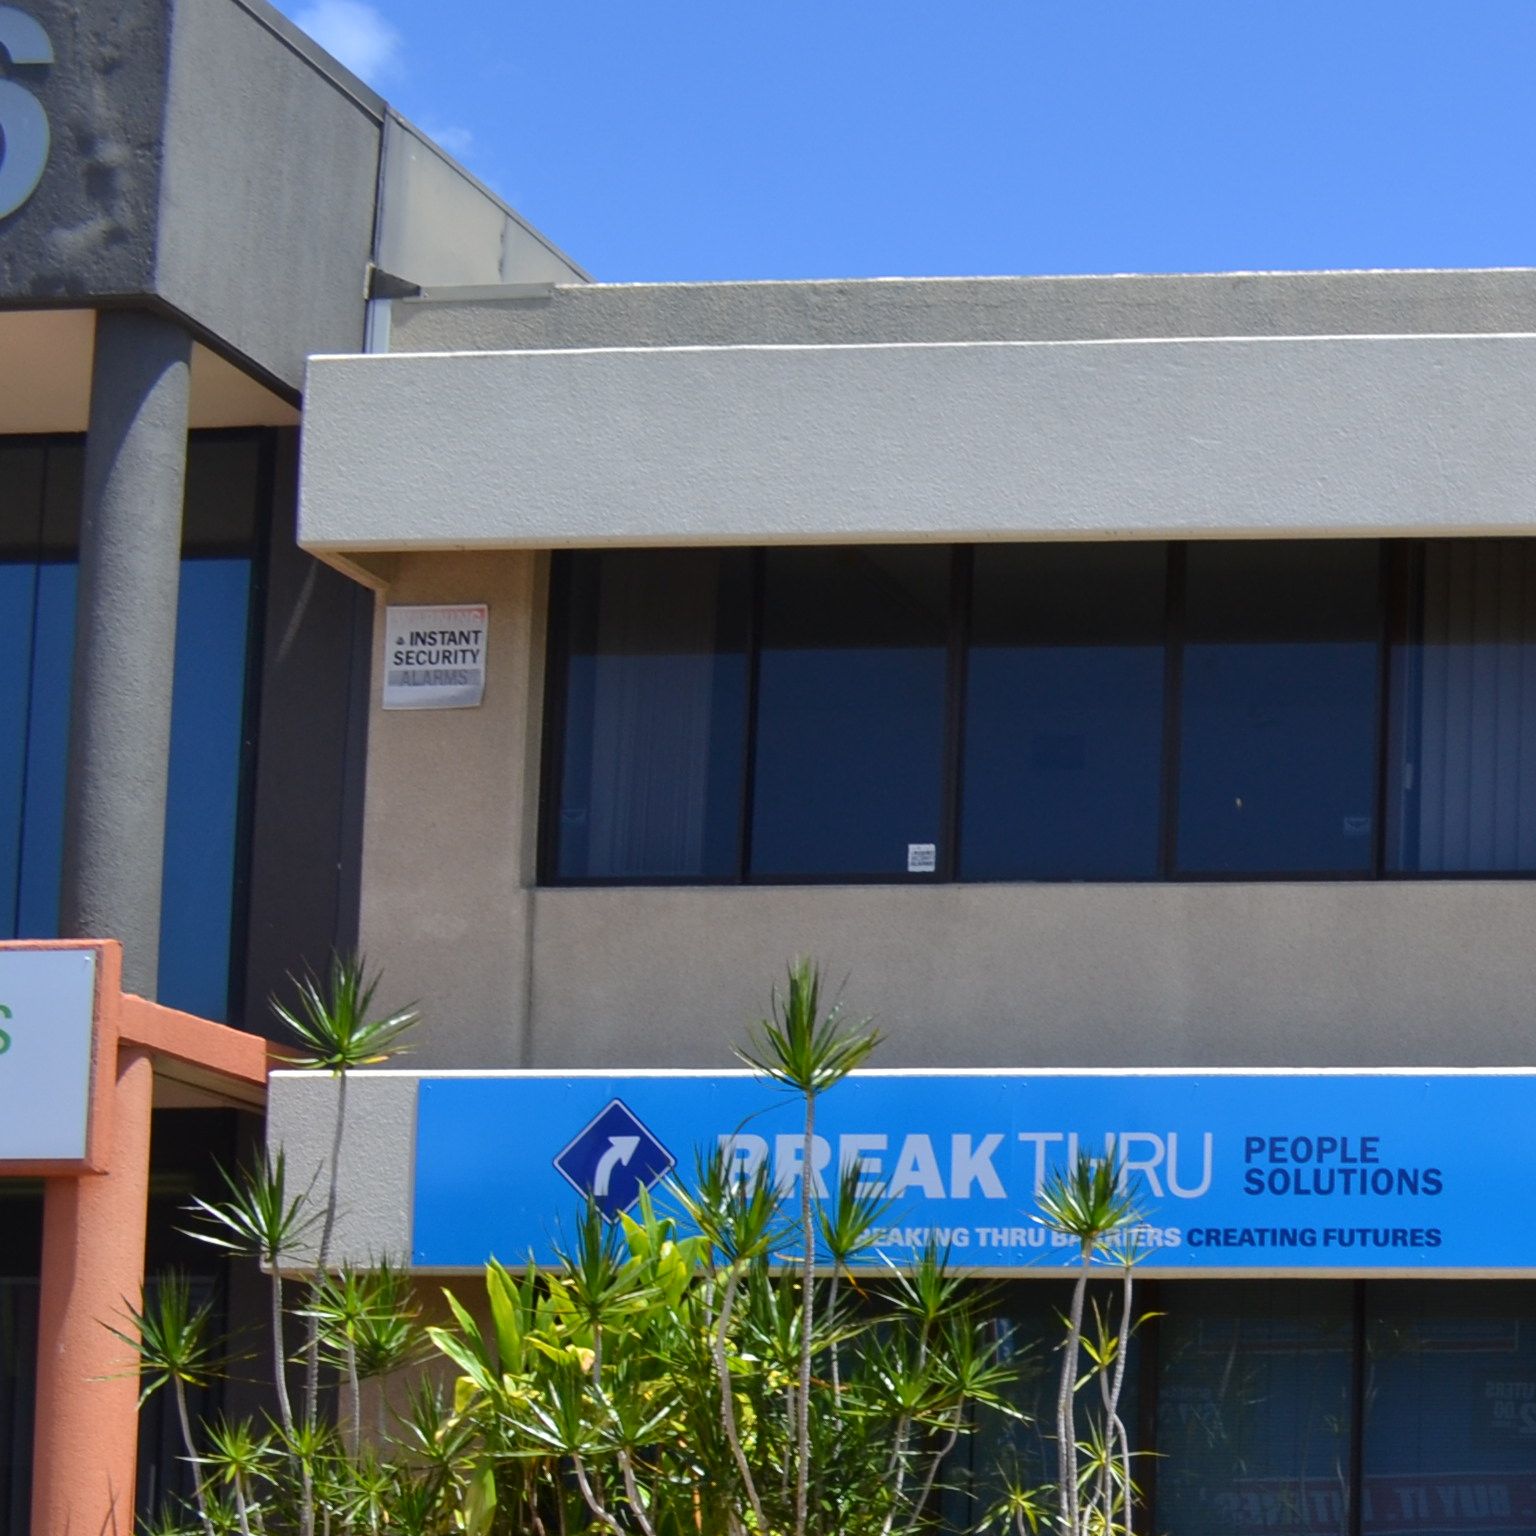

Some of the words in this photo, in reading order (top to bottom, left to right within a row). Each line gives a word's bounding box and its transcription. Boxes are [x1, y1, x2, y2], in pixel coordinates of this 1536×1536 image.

[410, 630, 482, 646] INSTANT
[393, 649, 480, 666] SECURITY
[401, 669, 468, 686] ALARMS
[1244, 1136, 1380, 1164] PEOPLE
[1243, 1167, 1443, 1196] SOLUTIONS
[976, 1227, 1047, 1248] THRU
[1187, 1227, 1317, 1248] CREATING
[1322, 1227, 1443, 1248] FUTURES
